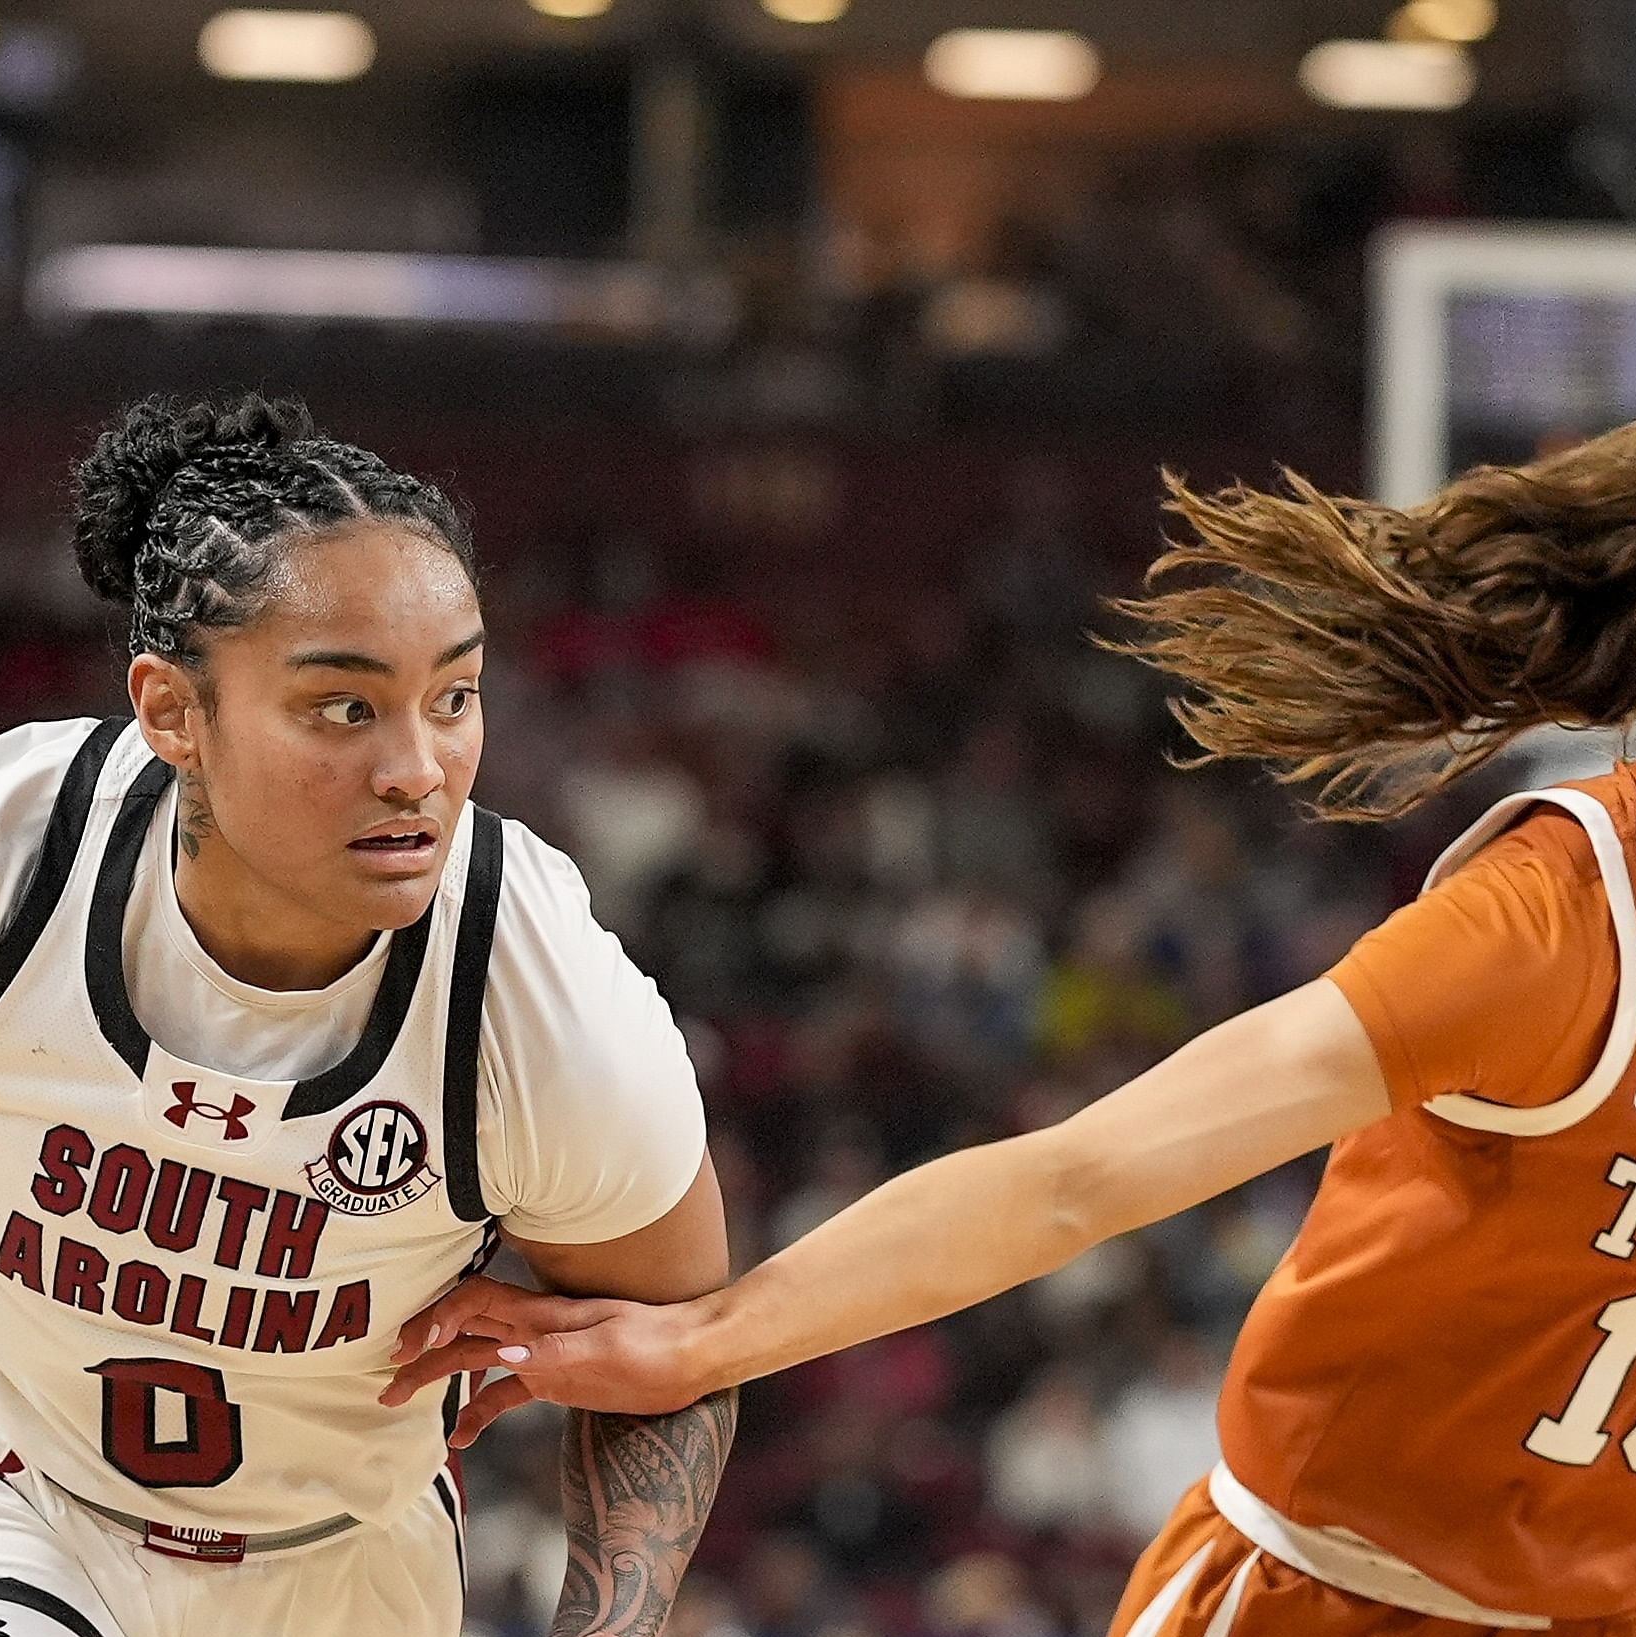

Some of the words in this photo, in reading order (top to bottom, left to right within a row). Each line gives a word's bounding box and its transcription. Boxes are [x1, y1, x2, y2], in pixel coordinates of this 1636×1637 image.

[318, 1178, 417, 1213] GRADUATE
[337, 1107, 419, 1187] SEC
[31, 1123, 331, 1281] SOUTH
[86, 1356, 241, 1488] 0
